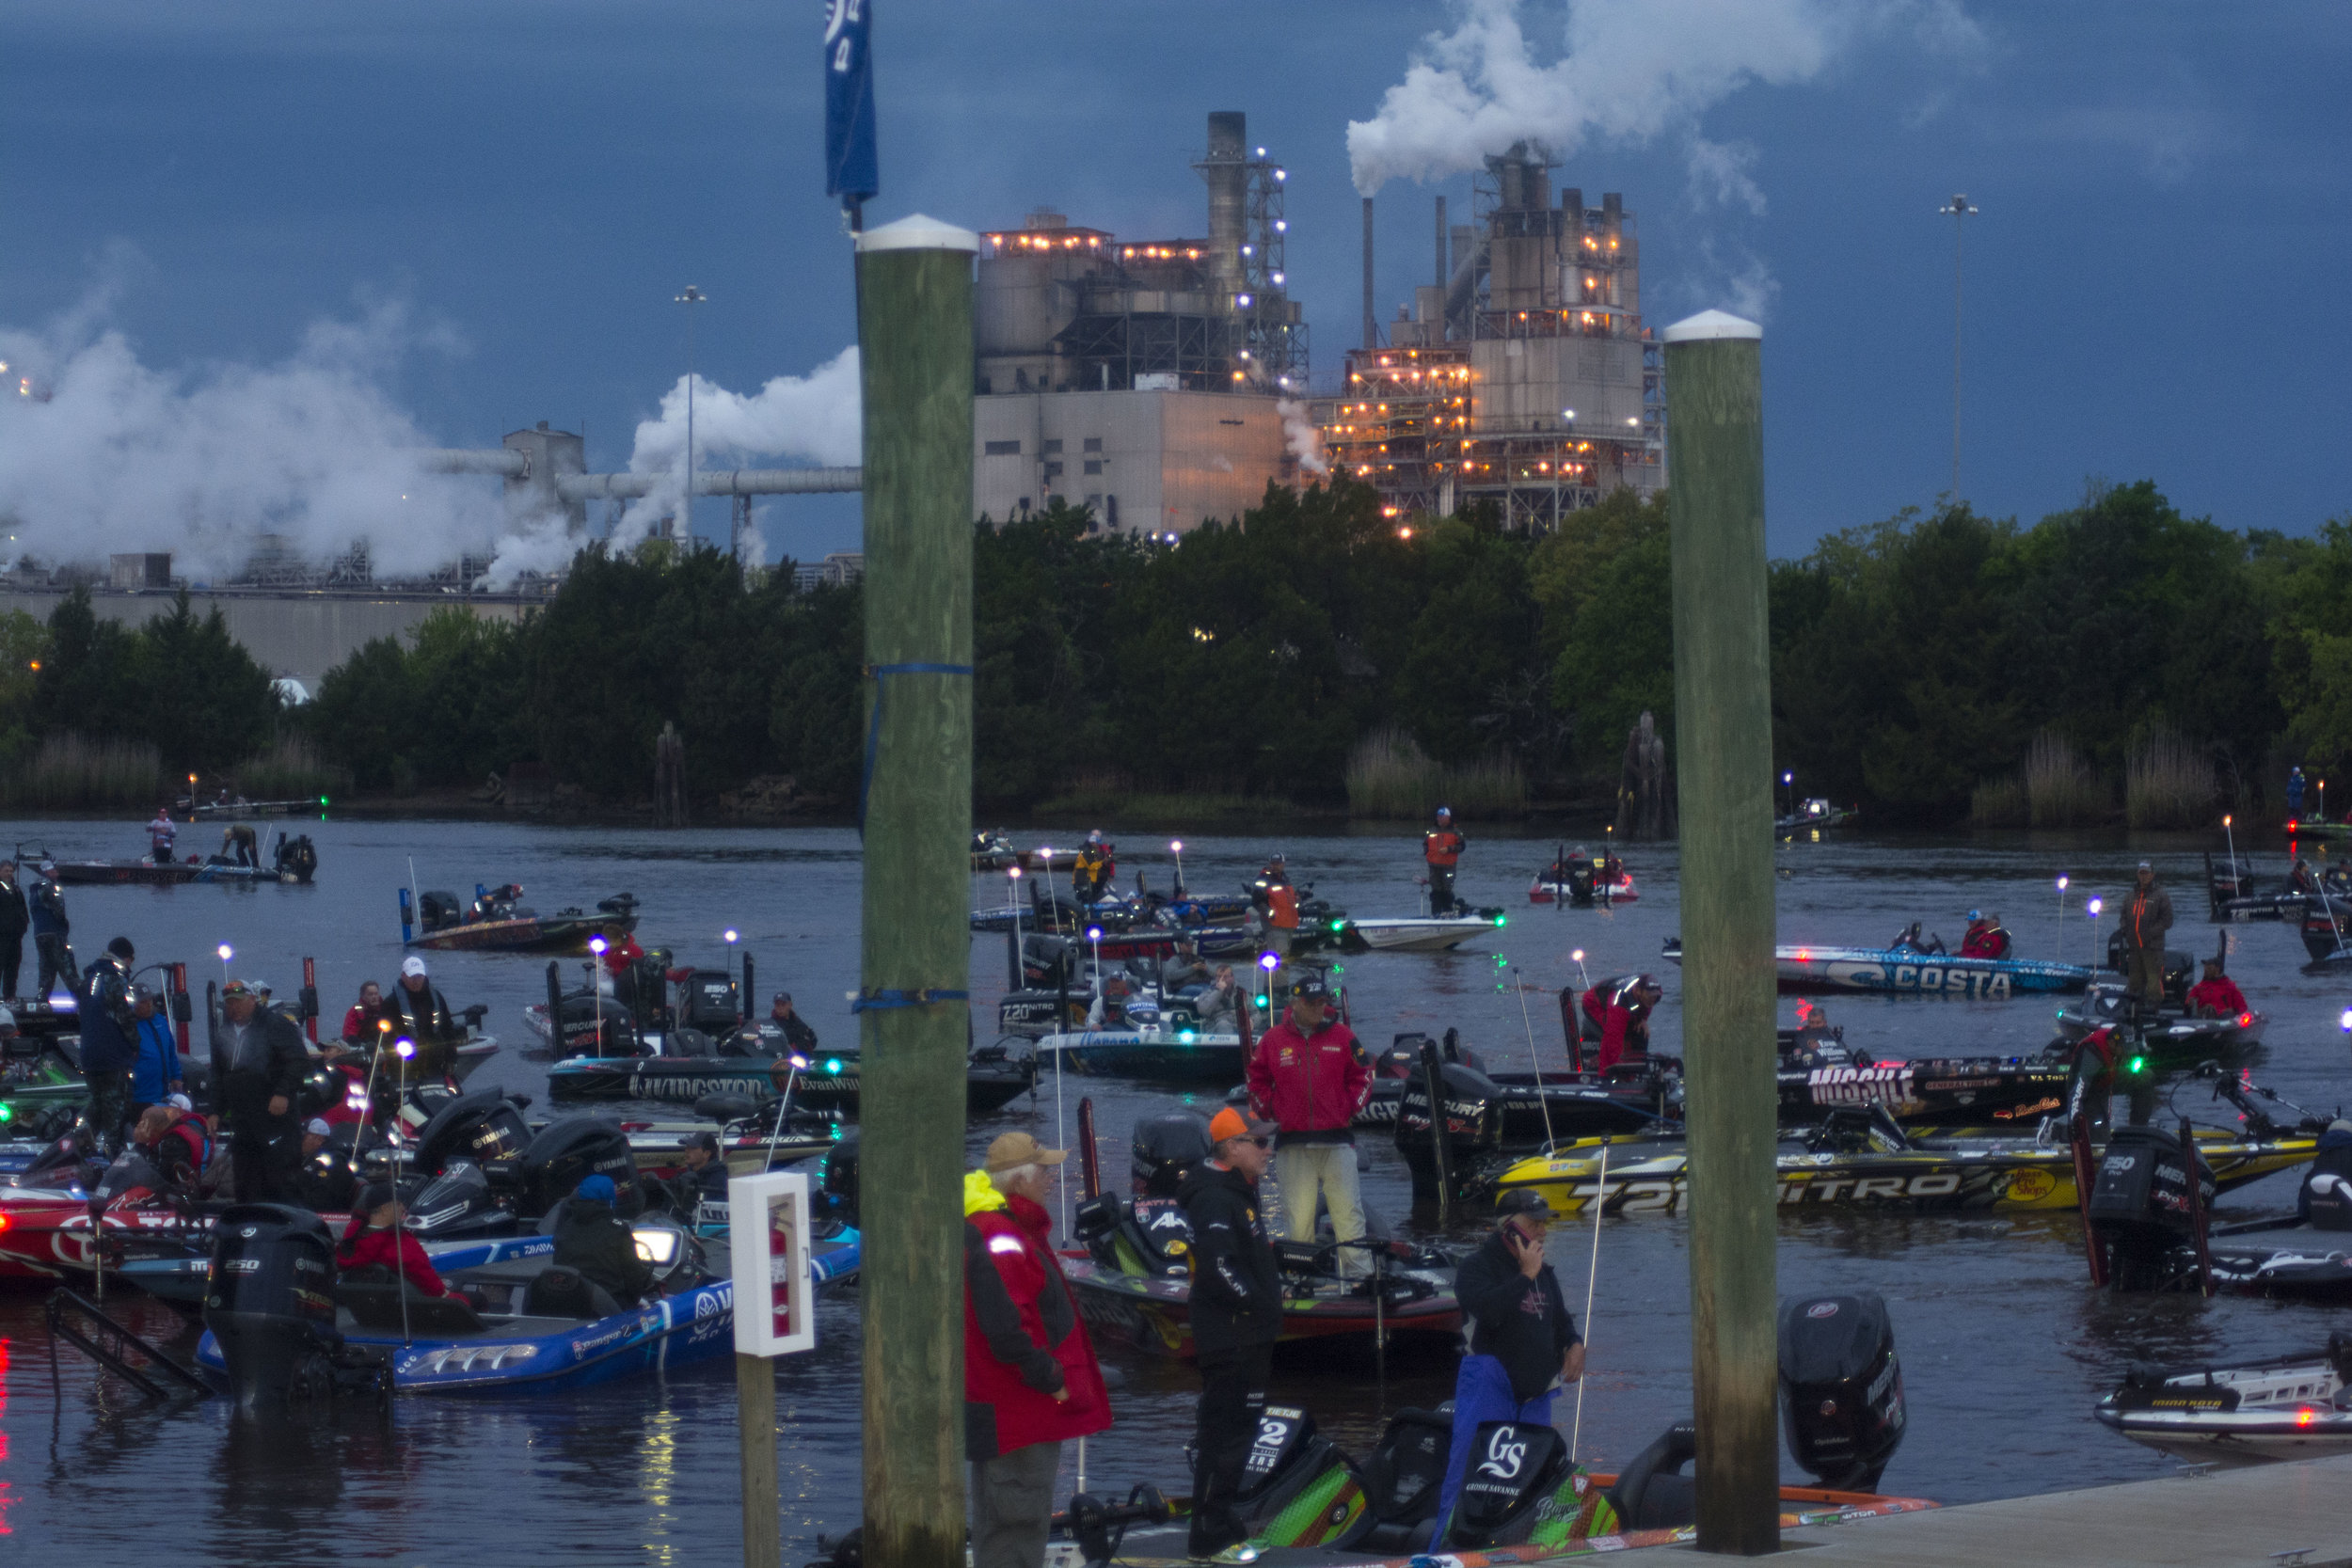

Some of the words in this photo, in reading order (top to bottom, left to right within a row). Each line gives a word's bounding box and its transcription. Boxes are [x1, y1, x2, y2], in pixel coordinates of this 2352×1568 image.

[1895, 965, 2011, 997] COSTA
[1003, 1005, 1028, 1021] Z20
[1029, 1003, 1055, 1011] NITRO
[1808, 1069, 1919, 1105] MISSILE
[1406, 1092, 1486, 1117] MECURY
[481, 1127, 510, 1145] YAMAHA
[2104, 1156, 2135, 1171] 250
[1776, 1174, 1963, 1203] ITRO
[2016, 1183, 2048, 1196] Shops
[225, 1259, 260, 1270] 250
[1466, 1482, 1489, 1493] GROSSE
[1488, 1483, 1520, 1496] SAVANNE
[1534, 1496, 1582, 1522] Bayou
